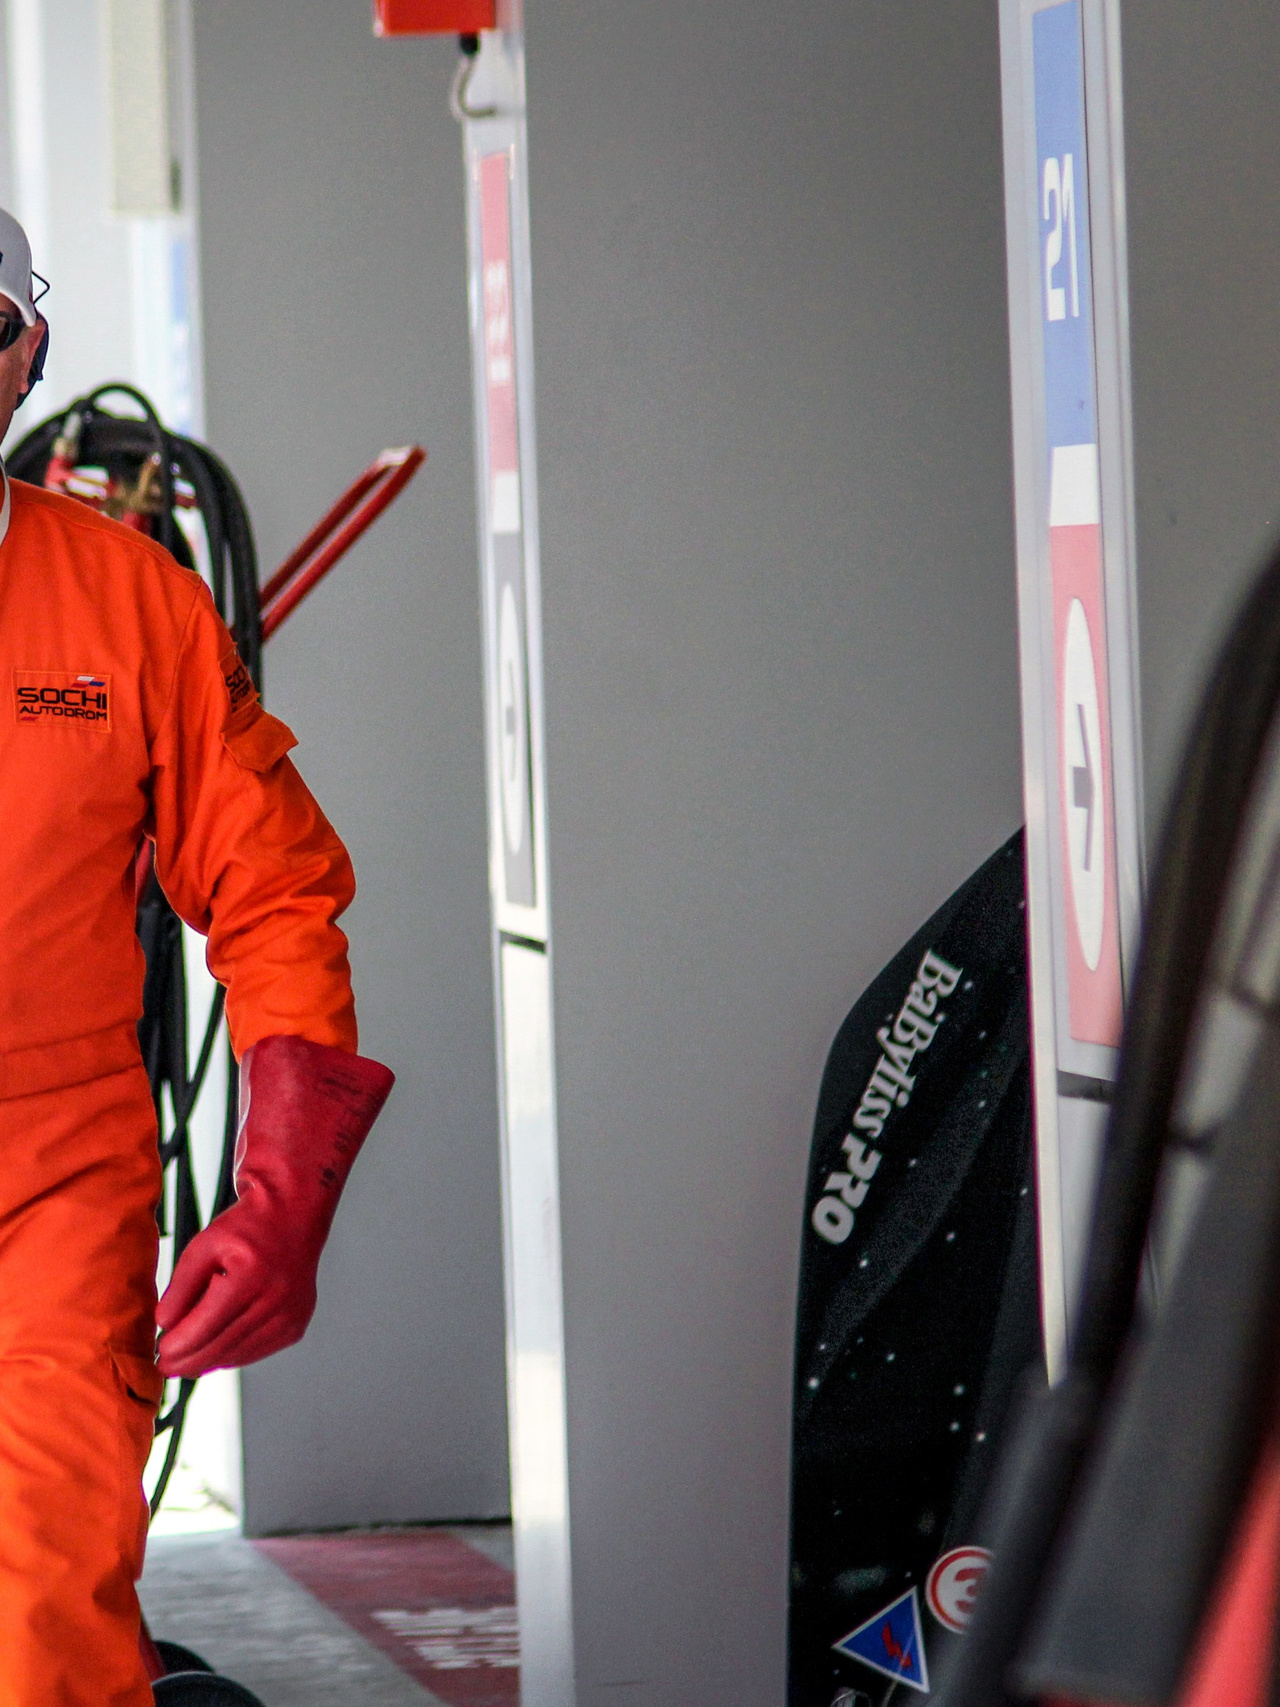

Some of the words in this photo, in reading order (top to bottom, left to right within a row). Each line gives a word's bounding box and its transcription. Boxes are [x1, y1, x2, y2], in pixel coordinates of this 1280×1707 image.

[1042, 152, 1080, 322] 21
[17, 687, 108, 710] SOCHI
[19, 705, 108, 721] AUTODROM
[811, 1132, 883, 1246] PRO
